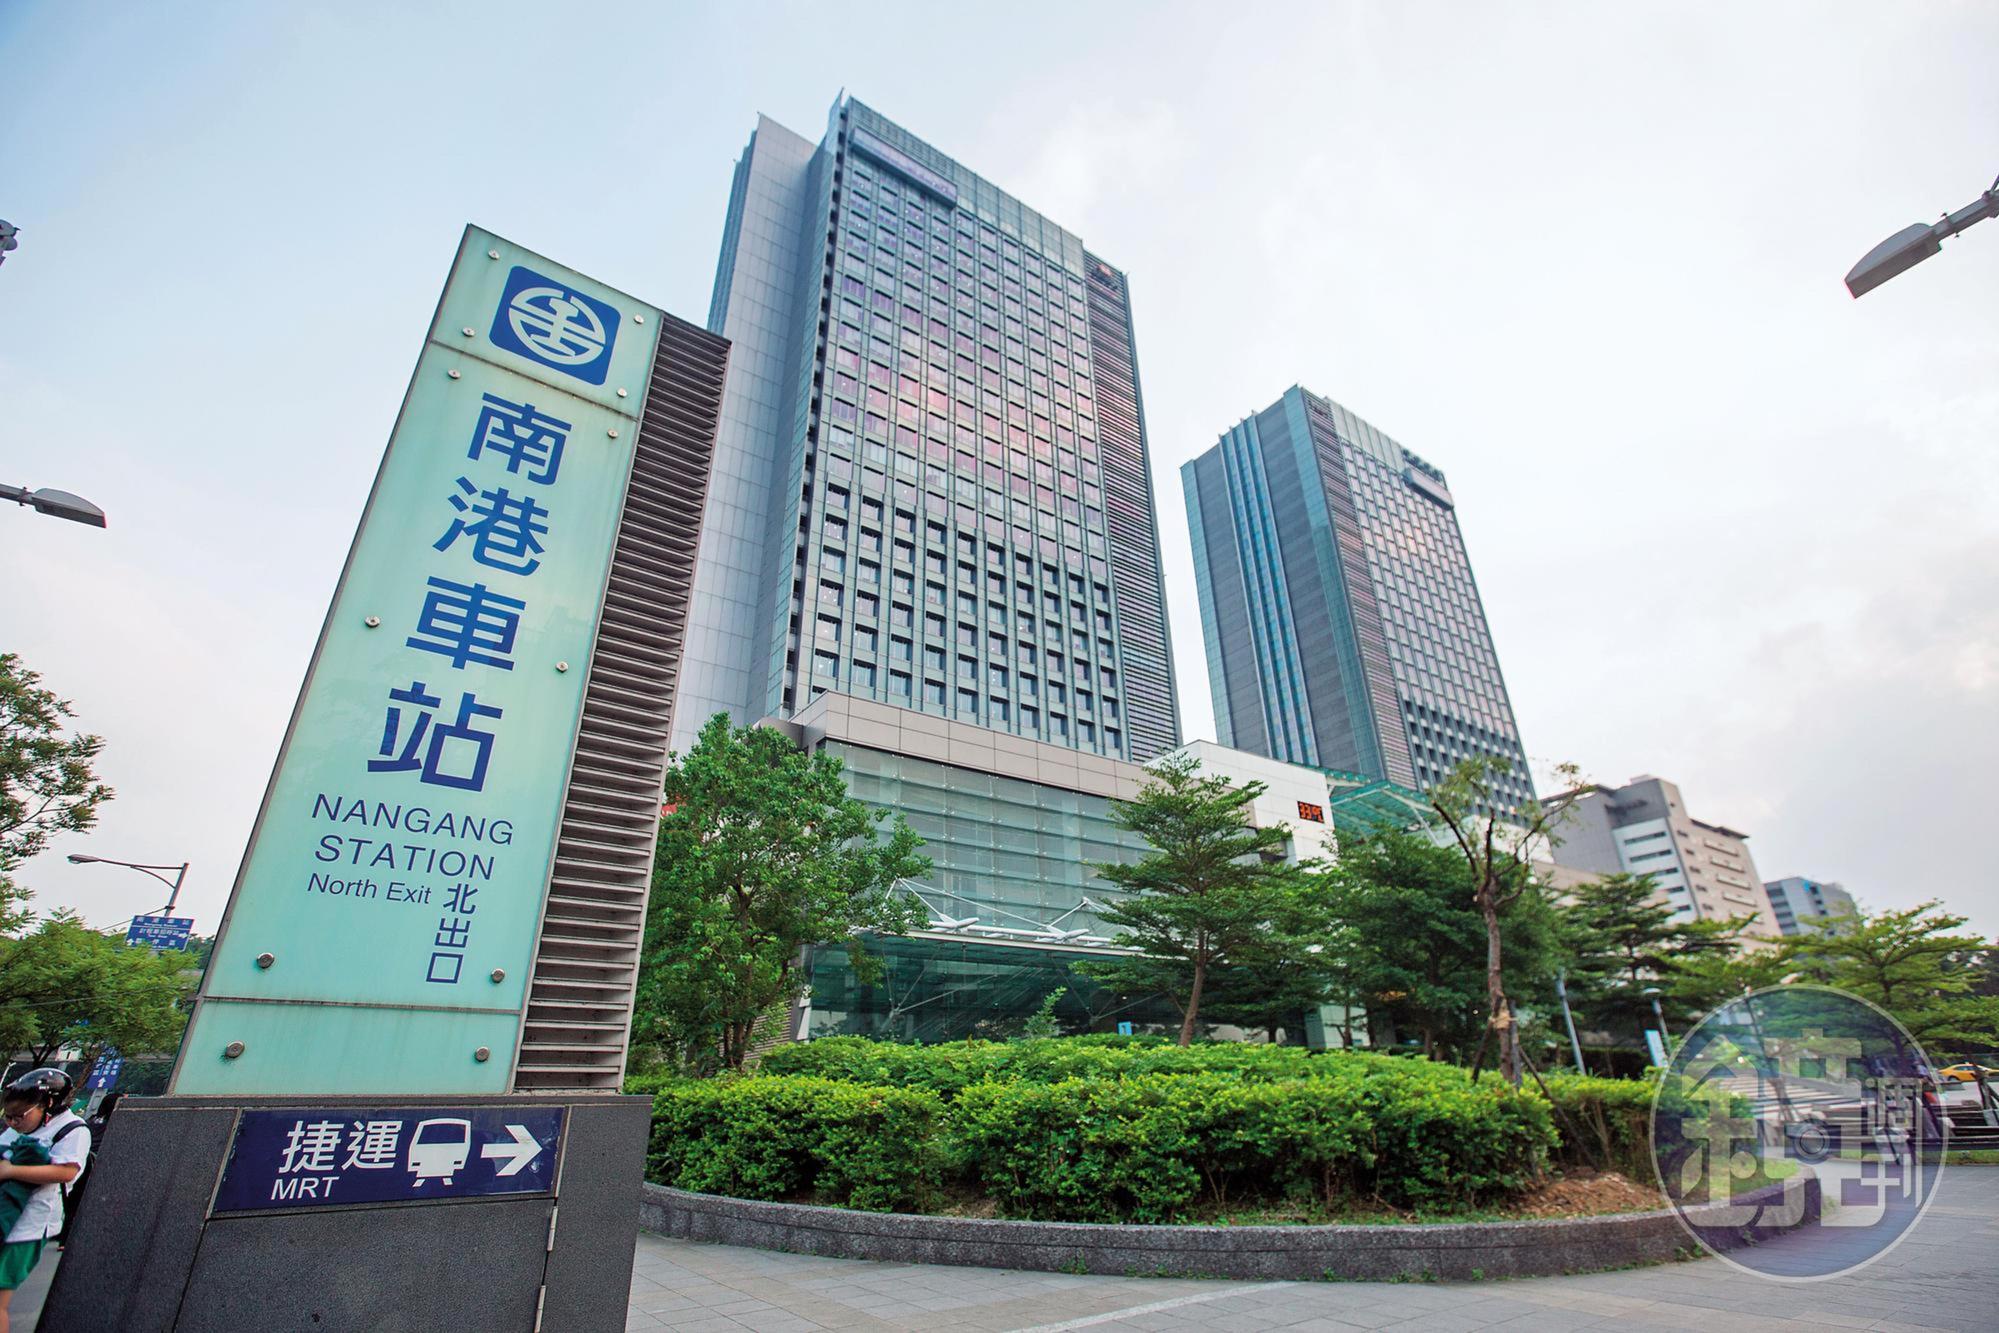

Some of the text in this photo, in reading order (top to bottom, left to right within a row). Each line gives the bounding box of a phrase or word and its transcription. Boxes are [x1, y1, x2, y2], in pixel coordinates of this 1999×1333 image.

[367, 391, 572, 792] 南港車站
[311, 793, 514, 845] NANGANG
[314, 834, 495, 880] STATION
[307, 872, 432, 905] North Exit
[425, 883, 478, 985] 北出口
[278, 1119, 404, 1173] 捷運
[271, 1176, 340, 1200] MRT
